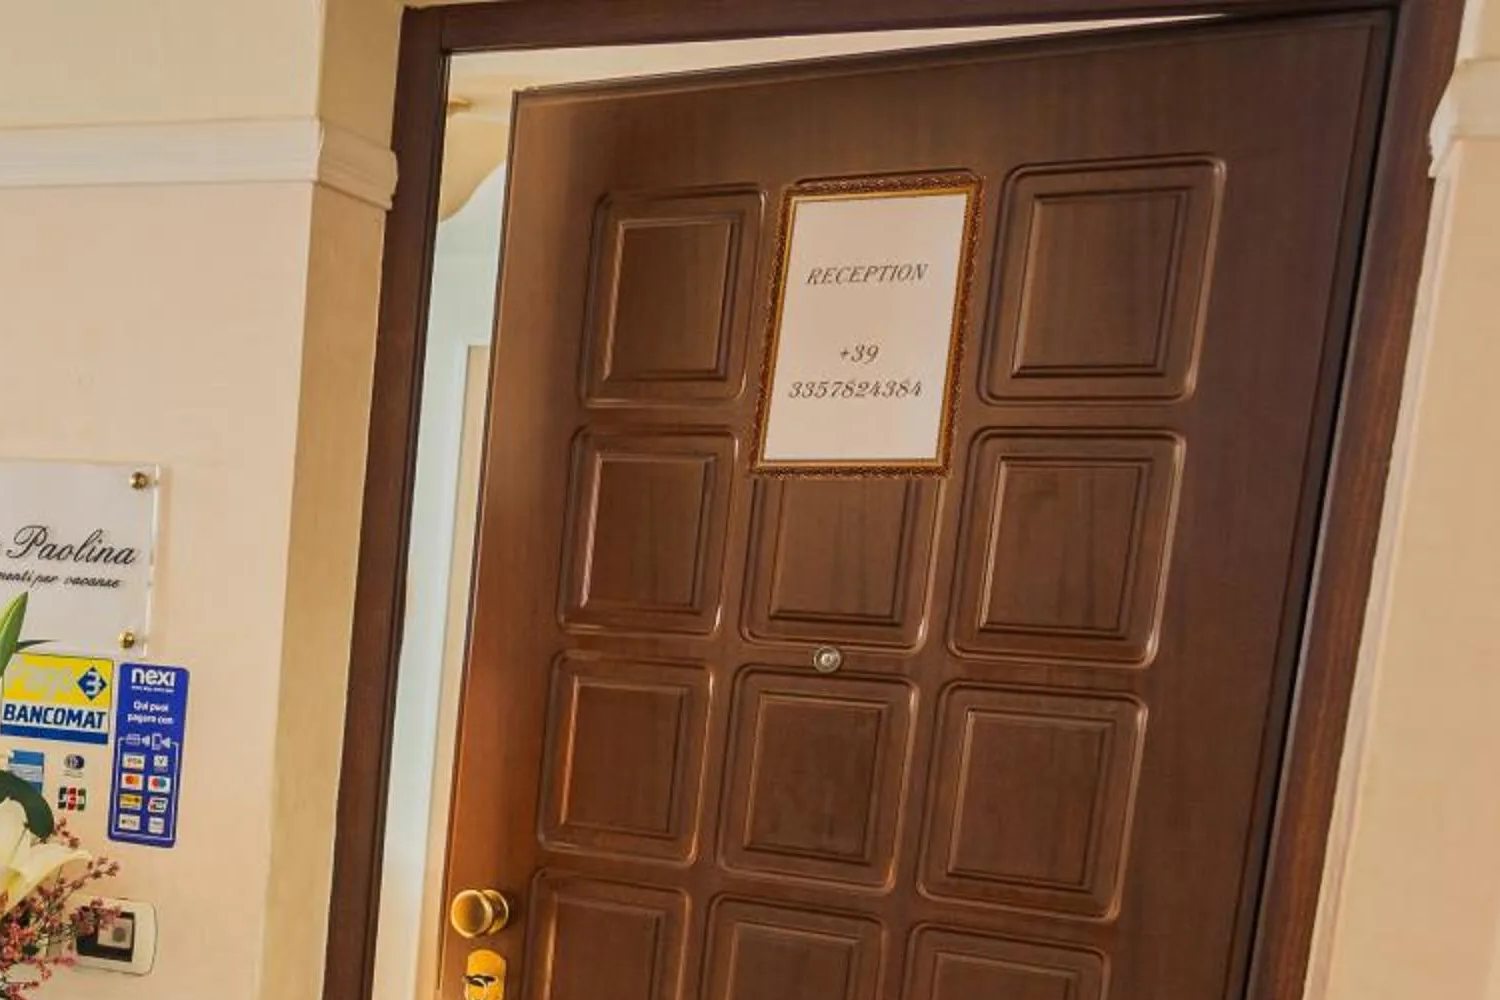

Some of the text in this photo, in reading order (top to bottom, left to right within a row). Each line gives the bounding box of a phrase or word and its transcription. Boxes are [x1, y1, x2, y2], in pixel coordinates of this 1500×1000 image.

[805, 263, 929, 285] RECEPTION
[840, 343, 880, 365] +39
[788, 380, 923, 400] 3357824384
[6, 525, 137, 566] Paolina
[131, 668, 176, 687] nexi
[3, 703, 107, 730] BANCOMAT
